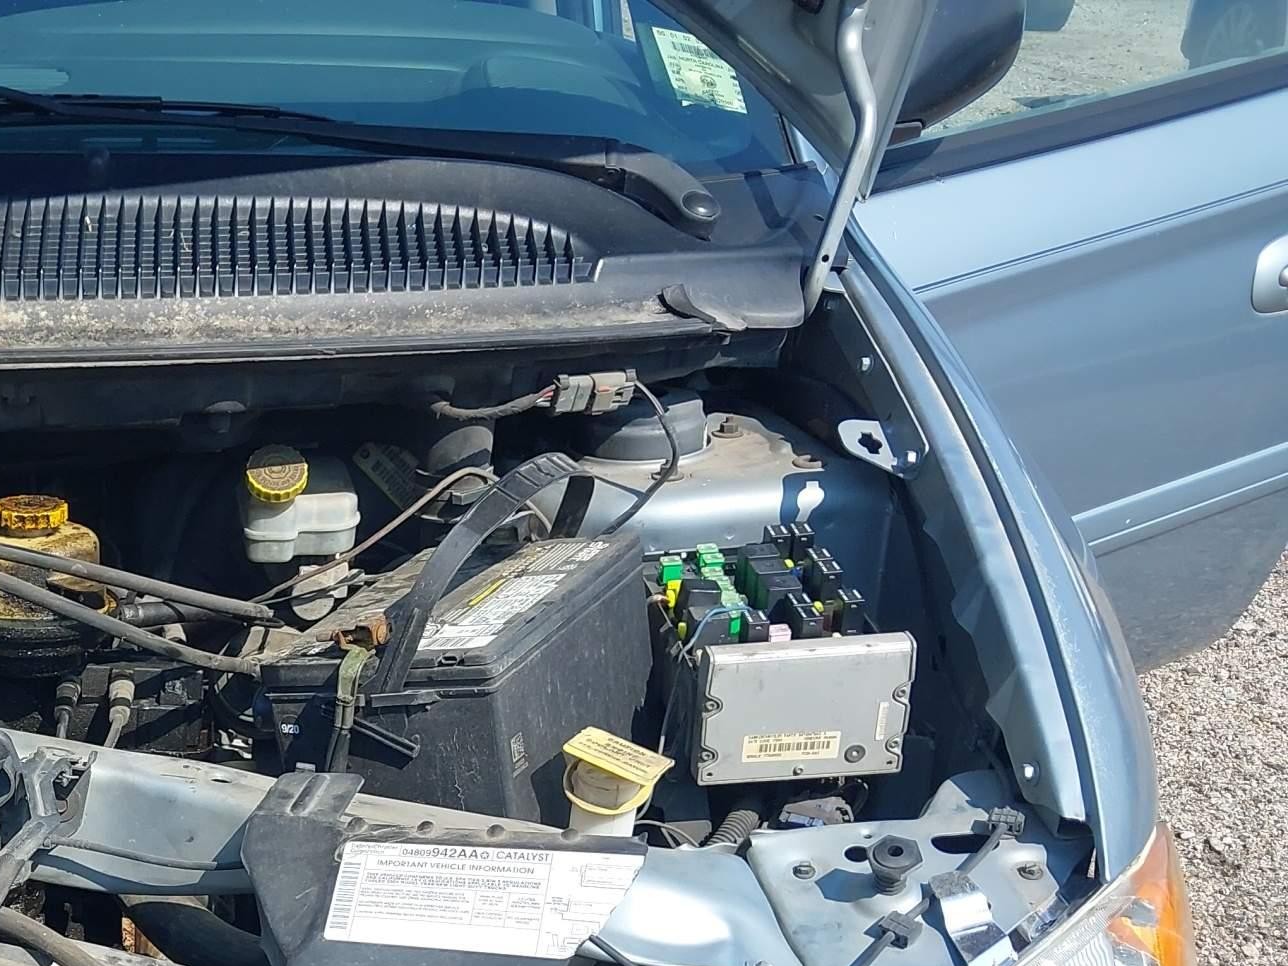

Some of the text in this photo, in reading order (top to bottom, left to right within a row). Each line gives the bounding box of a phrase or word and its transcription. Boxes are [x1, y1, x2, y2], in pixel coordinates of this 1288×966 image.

[281, 723, 300, 734] 9/20
[496, 850, 550, 862] CATALYST
[376, 859, 535, 875] IMPORTANT VEHICLE INFORMATION
